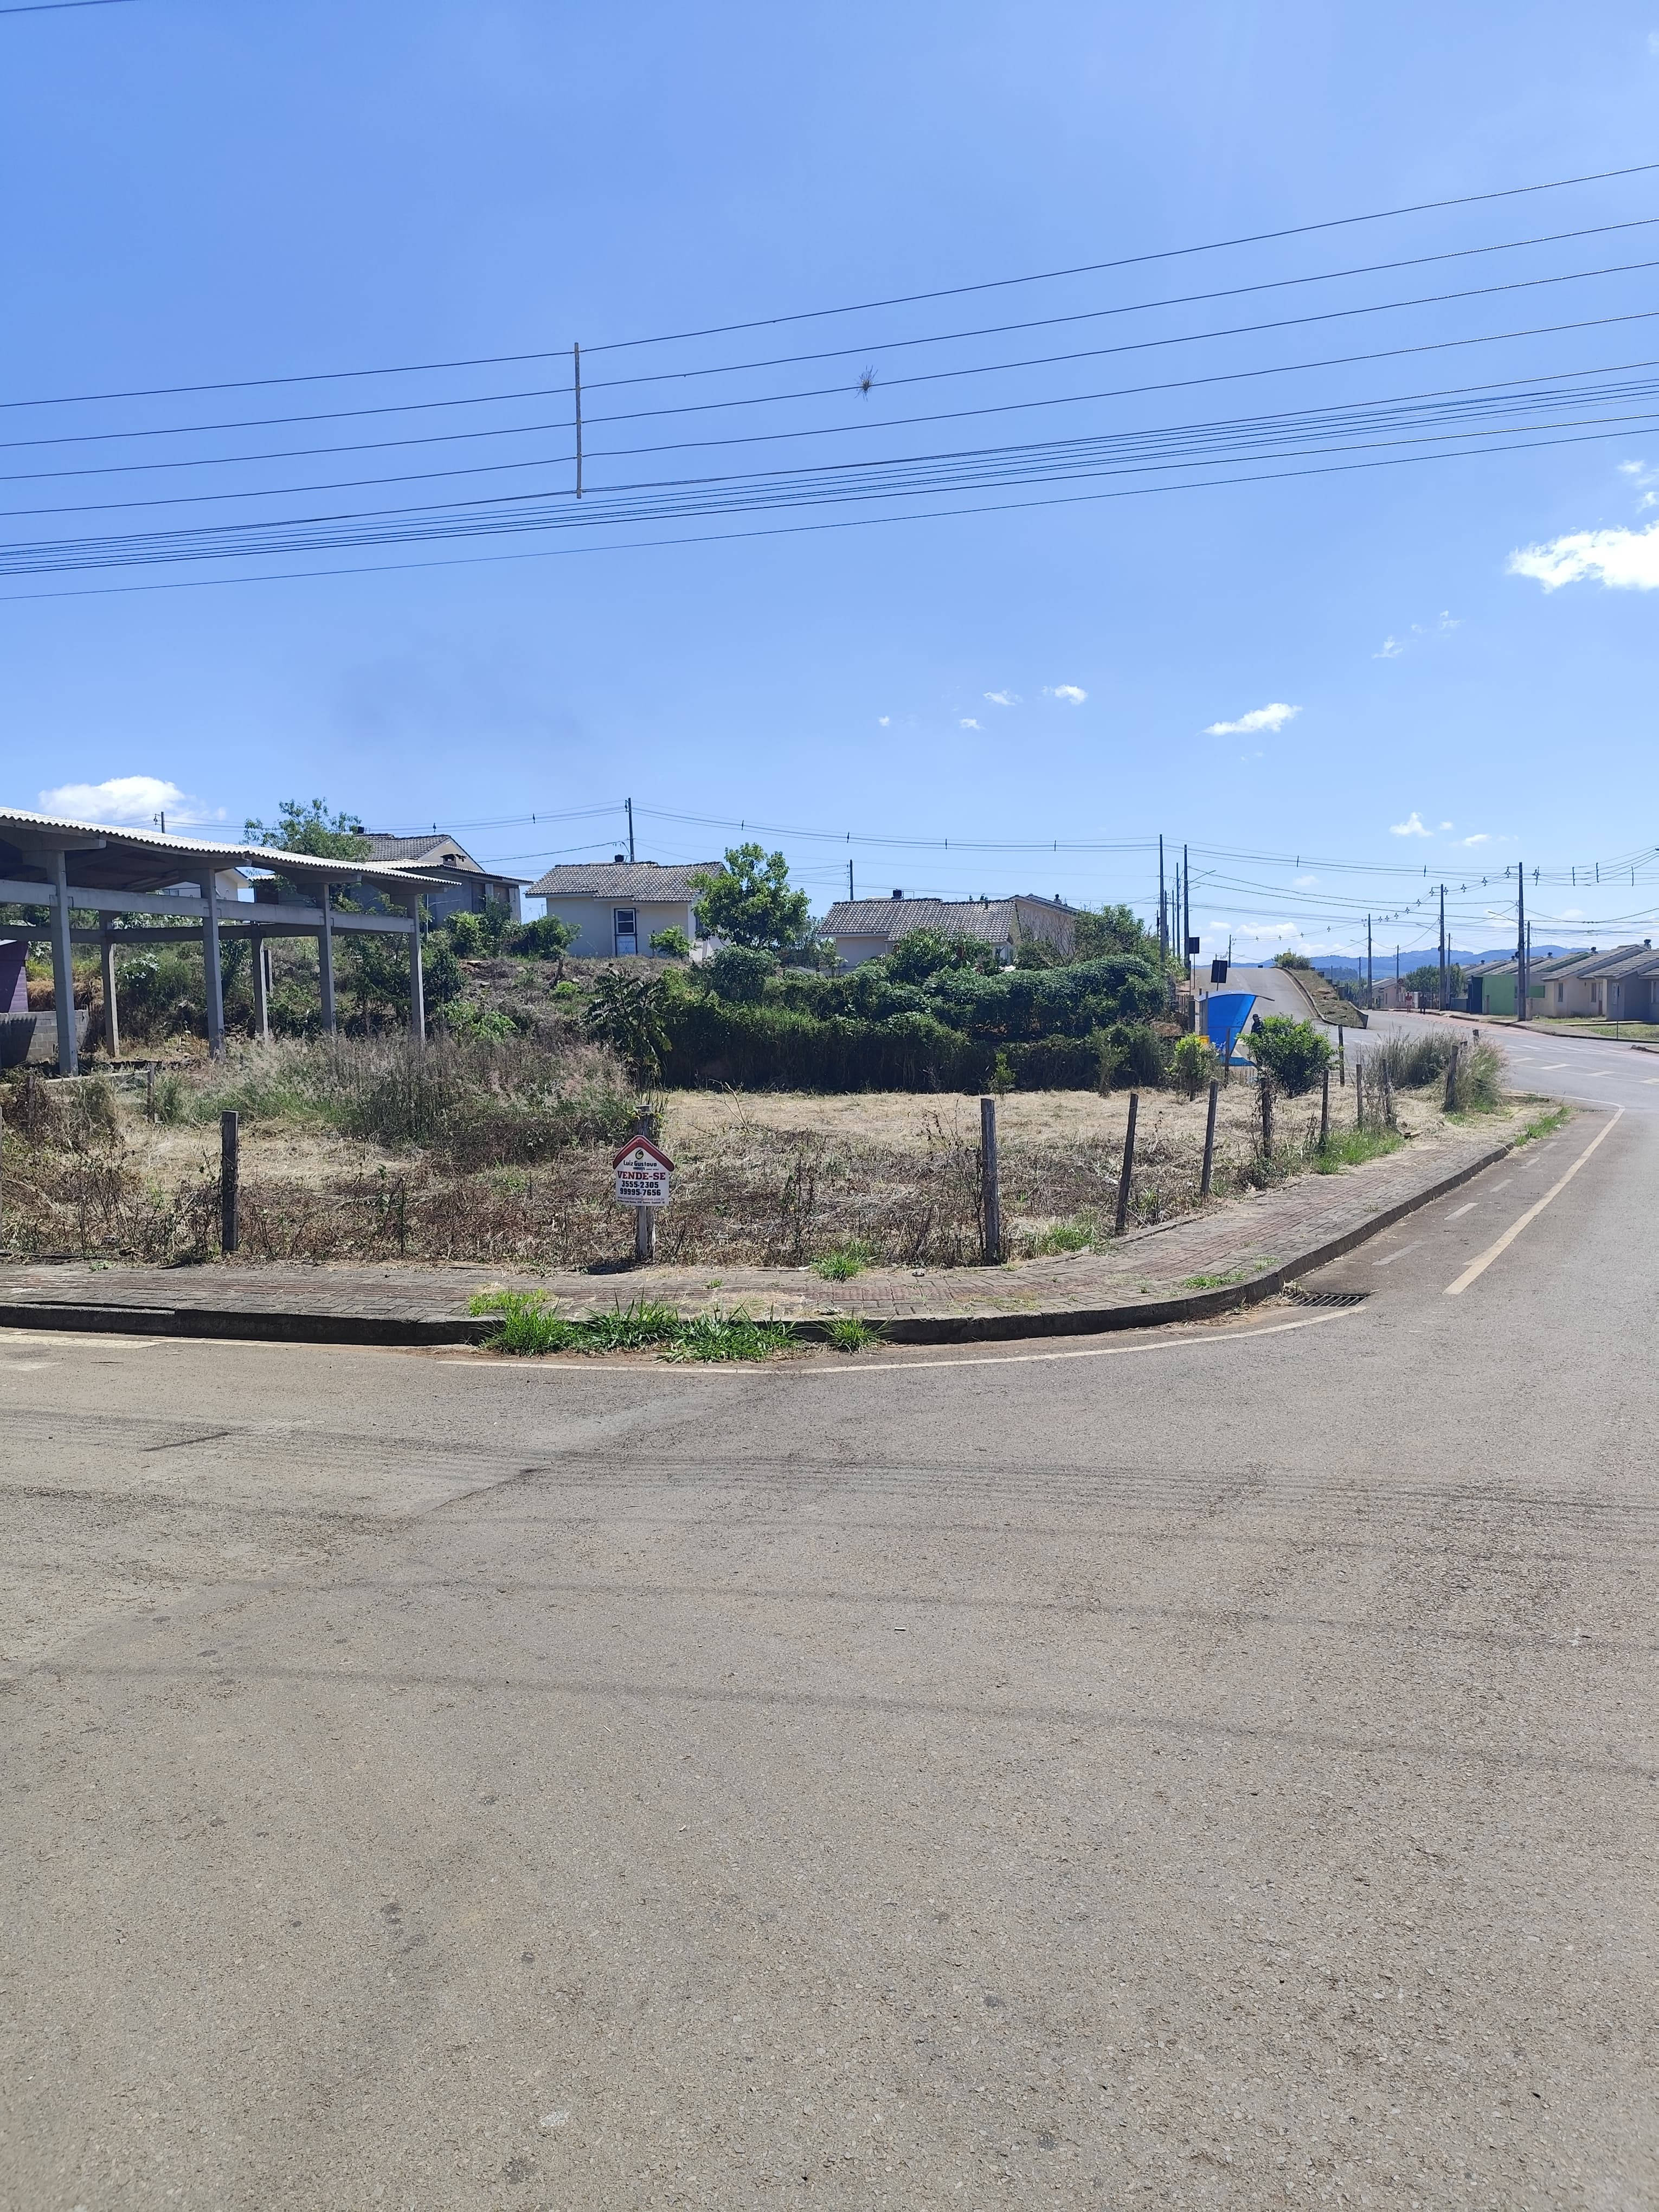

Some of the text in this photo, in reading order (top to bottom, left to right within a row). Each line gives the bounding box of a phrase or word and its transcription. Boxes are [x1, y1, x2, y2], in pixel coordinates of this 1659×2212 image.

[617, 1171, 666, 1180] VENDE-SE
[621, 1180, 659, 1188] 3555-2305
[620, 1187, 661, 1196] 99995-7656
